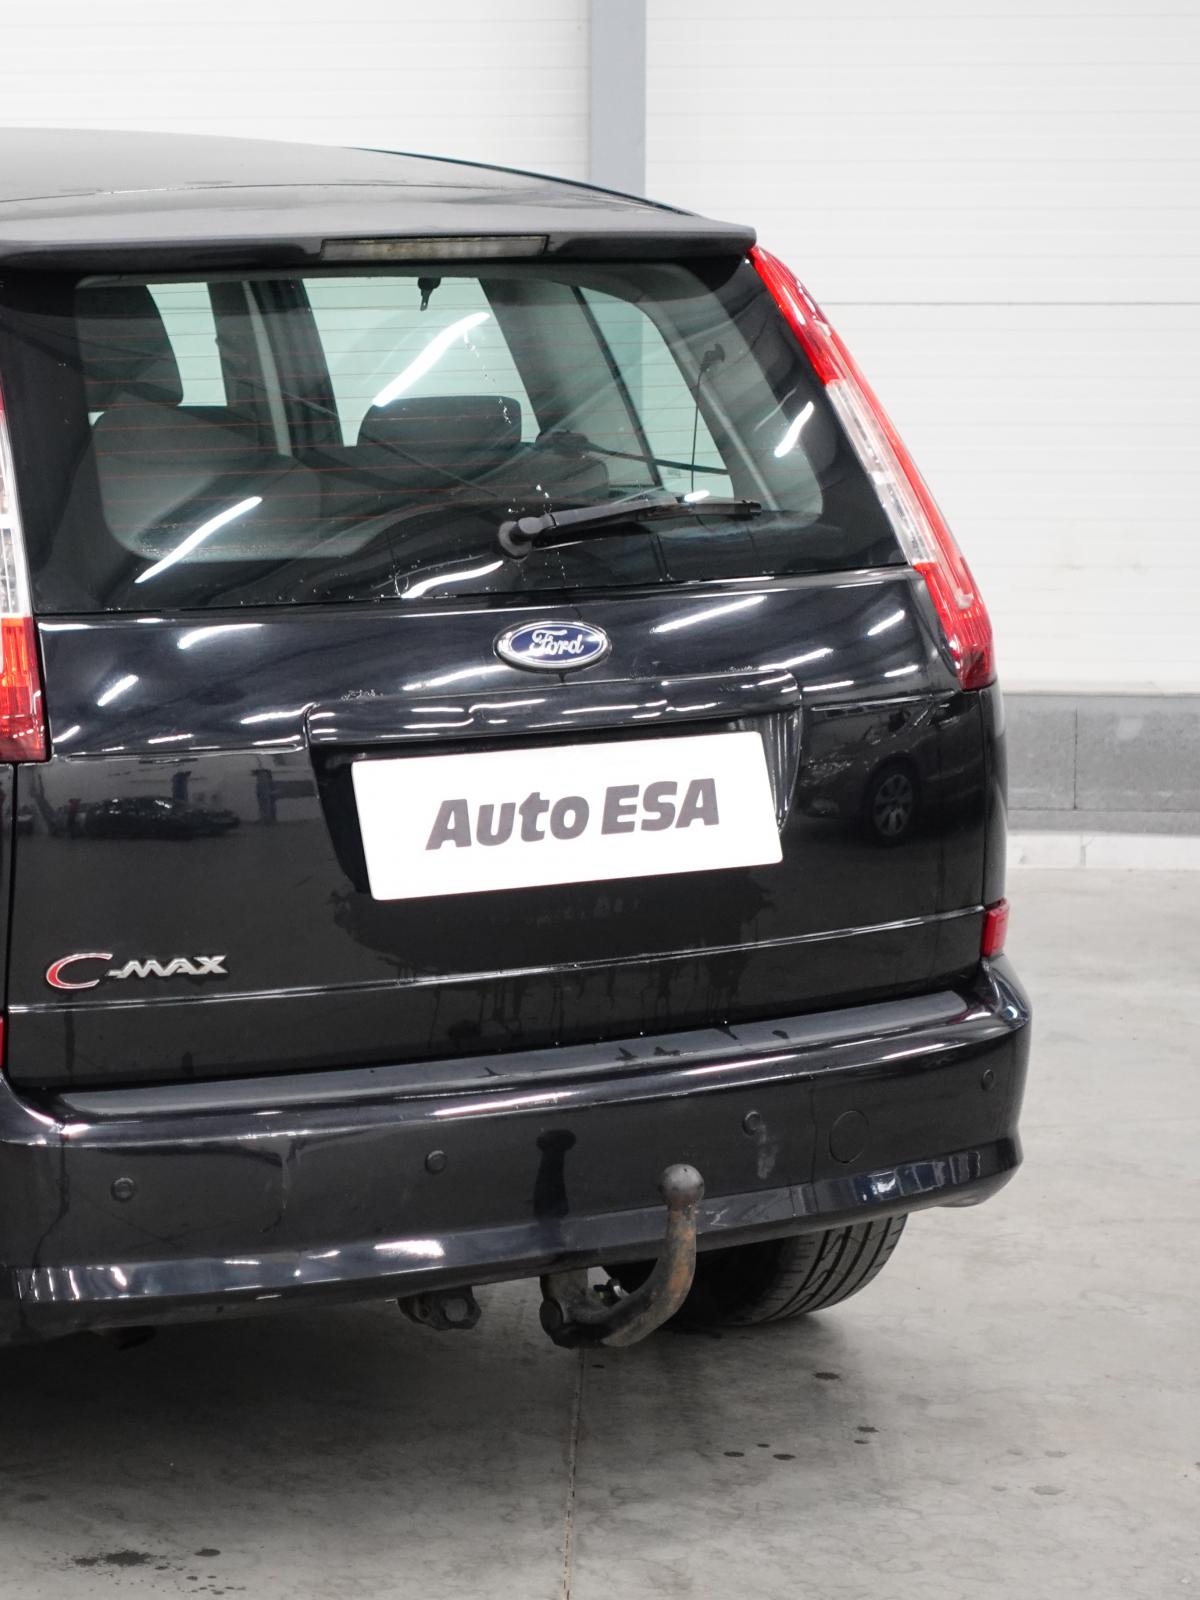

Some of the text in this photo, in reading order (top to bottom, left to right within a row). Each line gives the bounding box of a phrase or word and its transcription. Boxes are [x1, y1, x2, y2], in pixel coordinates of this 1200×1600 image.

[529, 629, 585, 656] Ford
[425, 778, 720, 851] Auto ESA
[46, 953, 228, 989] C-MAX
